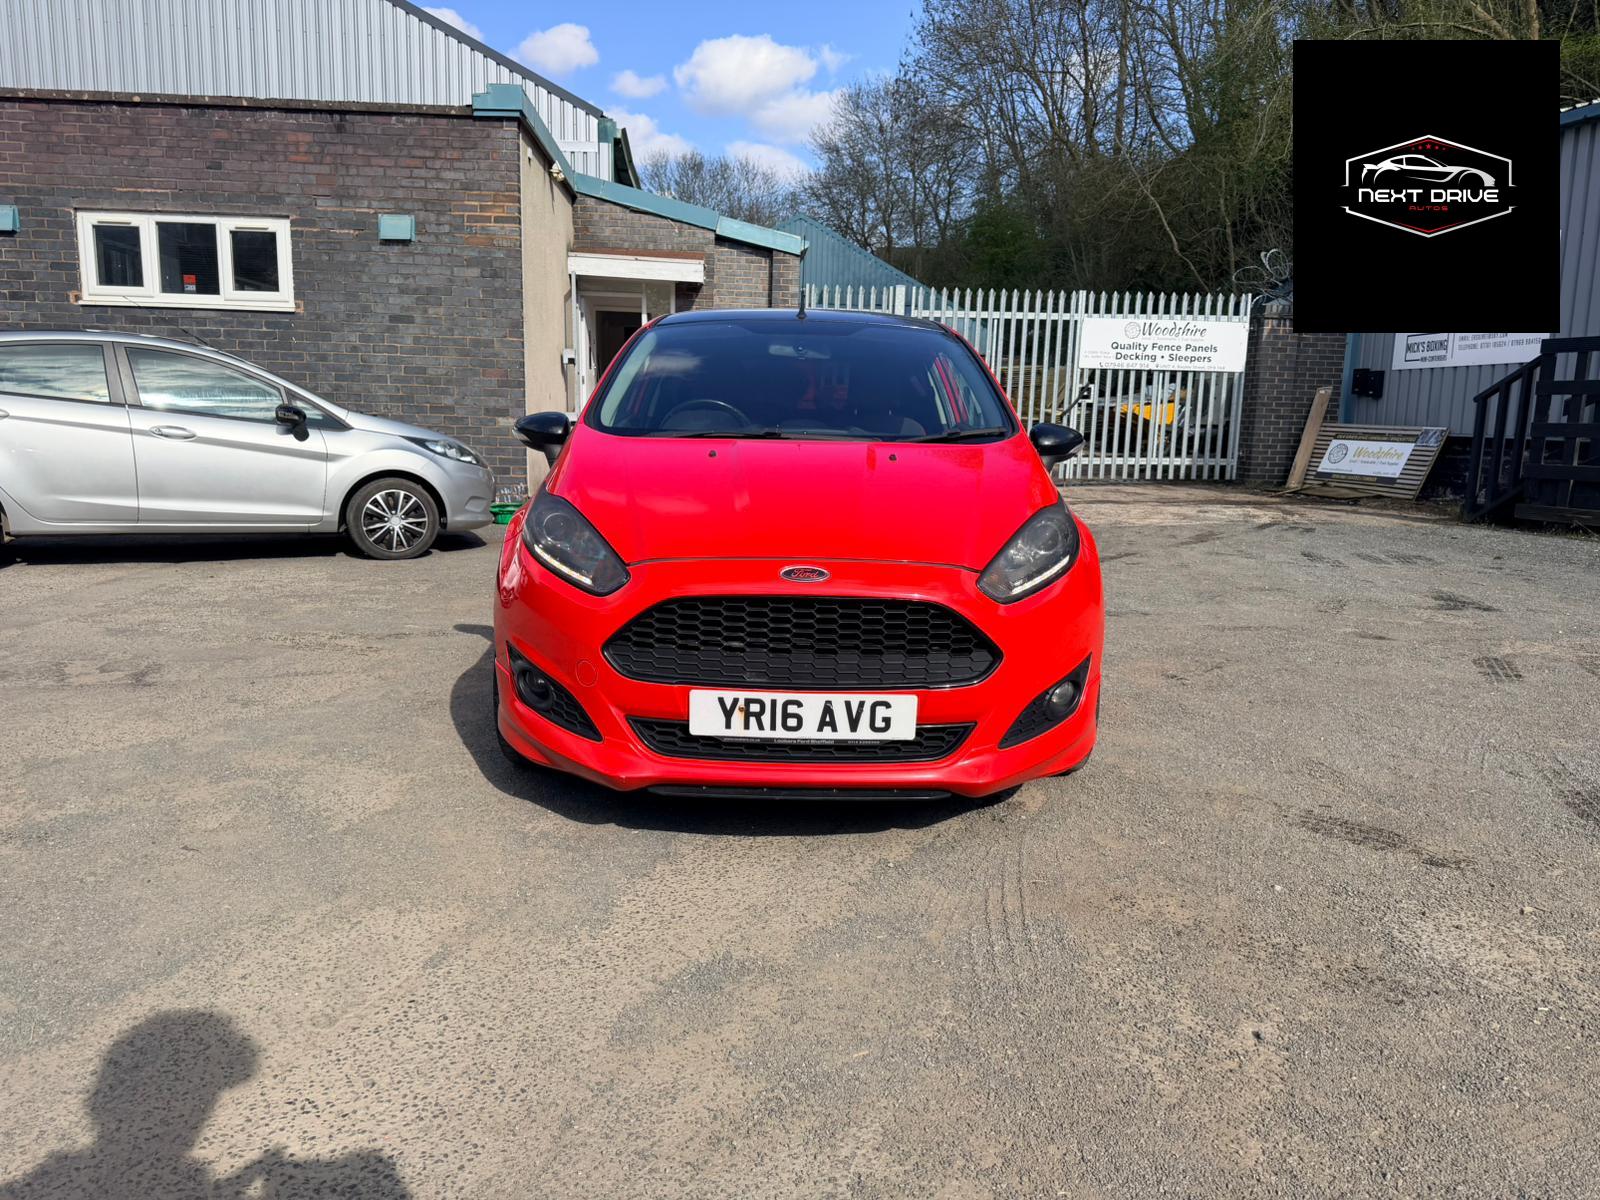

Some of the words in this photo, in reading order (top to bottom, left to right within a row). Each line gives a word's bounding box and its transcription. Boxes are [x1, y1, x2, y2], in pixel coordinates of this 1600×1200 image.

[1141, 321, 1207, 338] Woodshire
[1111, 341, 1148, 352] Quality
[1151, 342, 1182, 352] Fence
[1185, 343, 1218, 353] Panels
[1115, 352, 1157, 362] Decking
[1168, 353, 1212, 363] Sleepers
[1353, 446, 1404, 460] Woodshire
[791, 568, 819, 578] Ford
[717, 696, 804, 732] YR16
[816, 700, 893, 733] AVG
